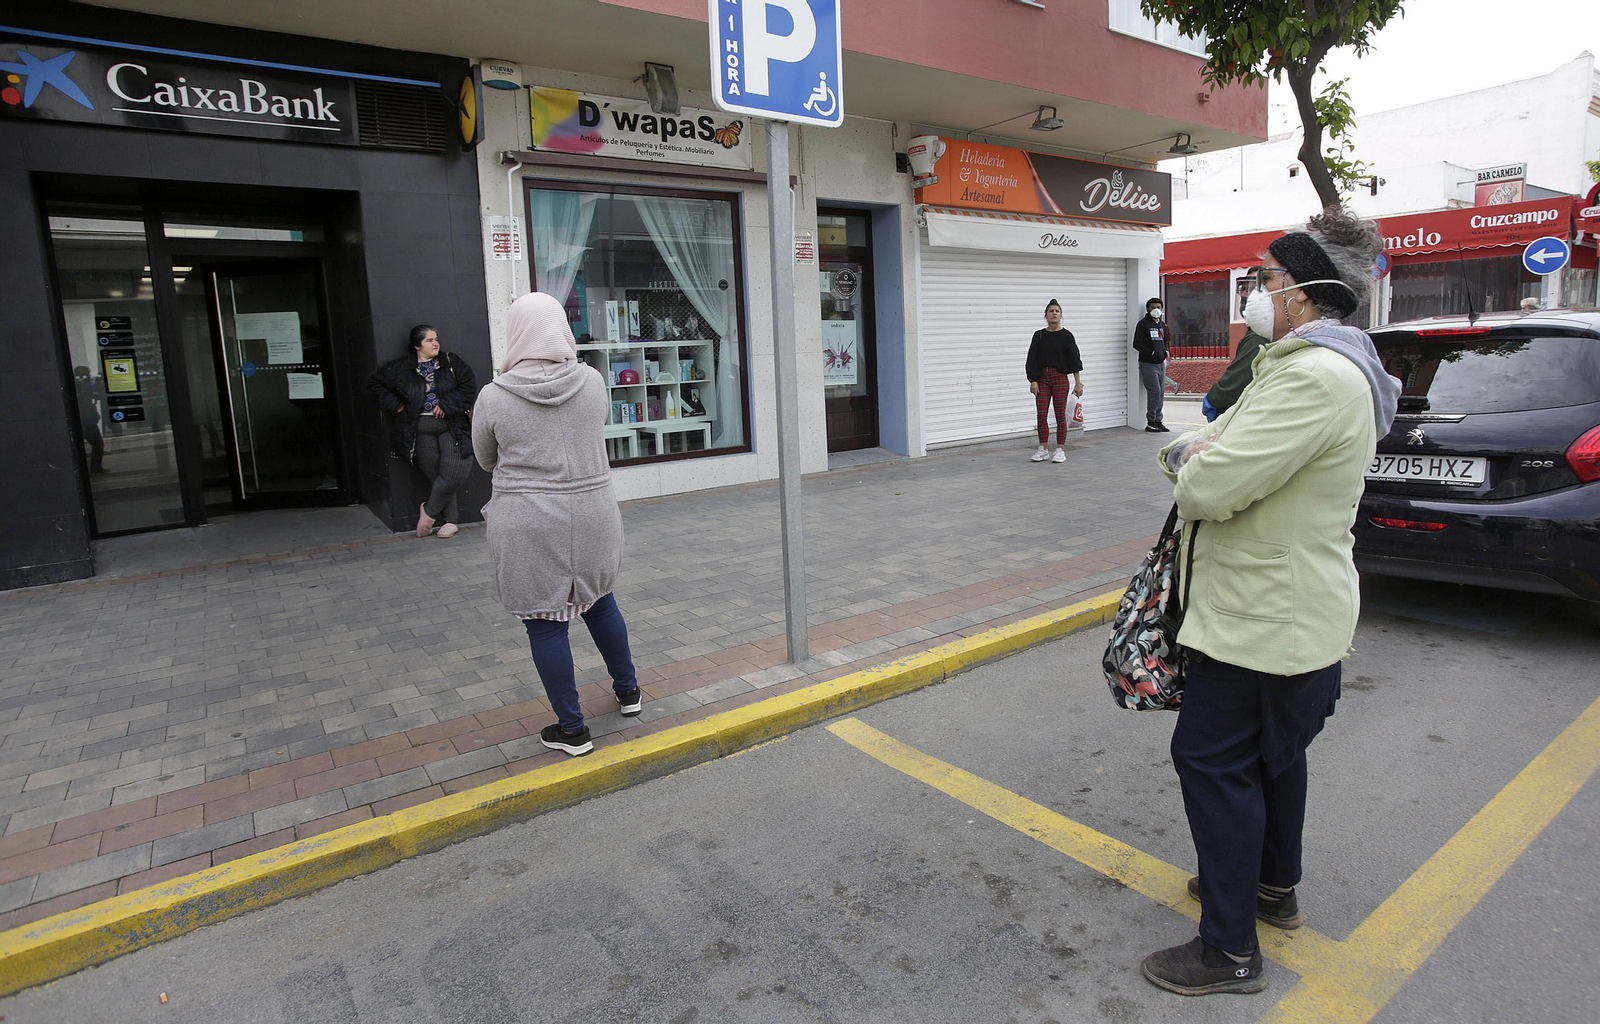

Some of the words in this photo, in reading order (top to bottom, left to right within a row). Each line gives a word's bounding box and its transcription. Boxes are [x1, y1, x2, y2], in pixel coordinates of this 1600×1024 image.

[742, 0, 817, 97] P
[726, 39, 741, 96] HORA
[106, 62, 340, 122] CaixaBank
[610, 138, 619, 146] de
[653, 143, 659, 151] y
[685, 146, 715, 156] Mobiliario
[636, 149, 665, 158] Perfumes
[960, 148, 1006, 168] Heladería
[959, 167, 972, 182] &
[975, 168, 1018, 188] Yogurtería
[1477, 171, 1491, 182] BAR
[1491, 166, 1523, 179] CARMELO
[960, 186, 1006, 205] Artesanal
[1470, 209, 1559, 228] Cruzcampo
[1038, 232, 1079, 248] Delice
[1369, 456, 1424, 476] 9705
[1428, 458, 1475, 478] HXZ
